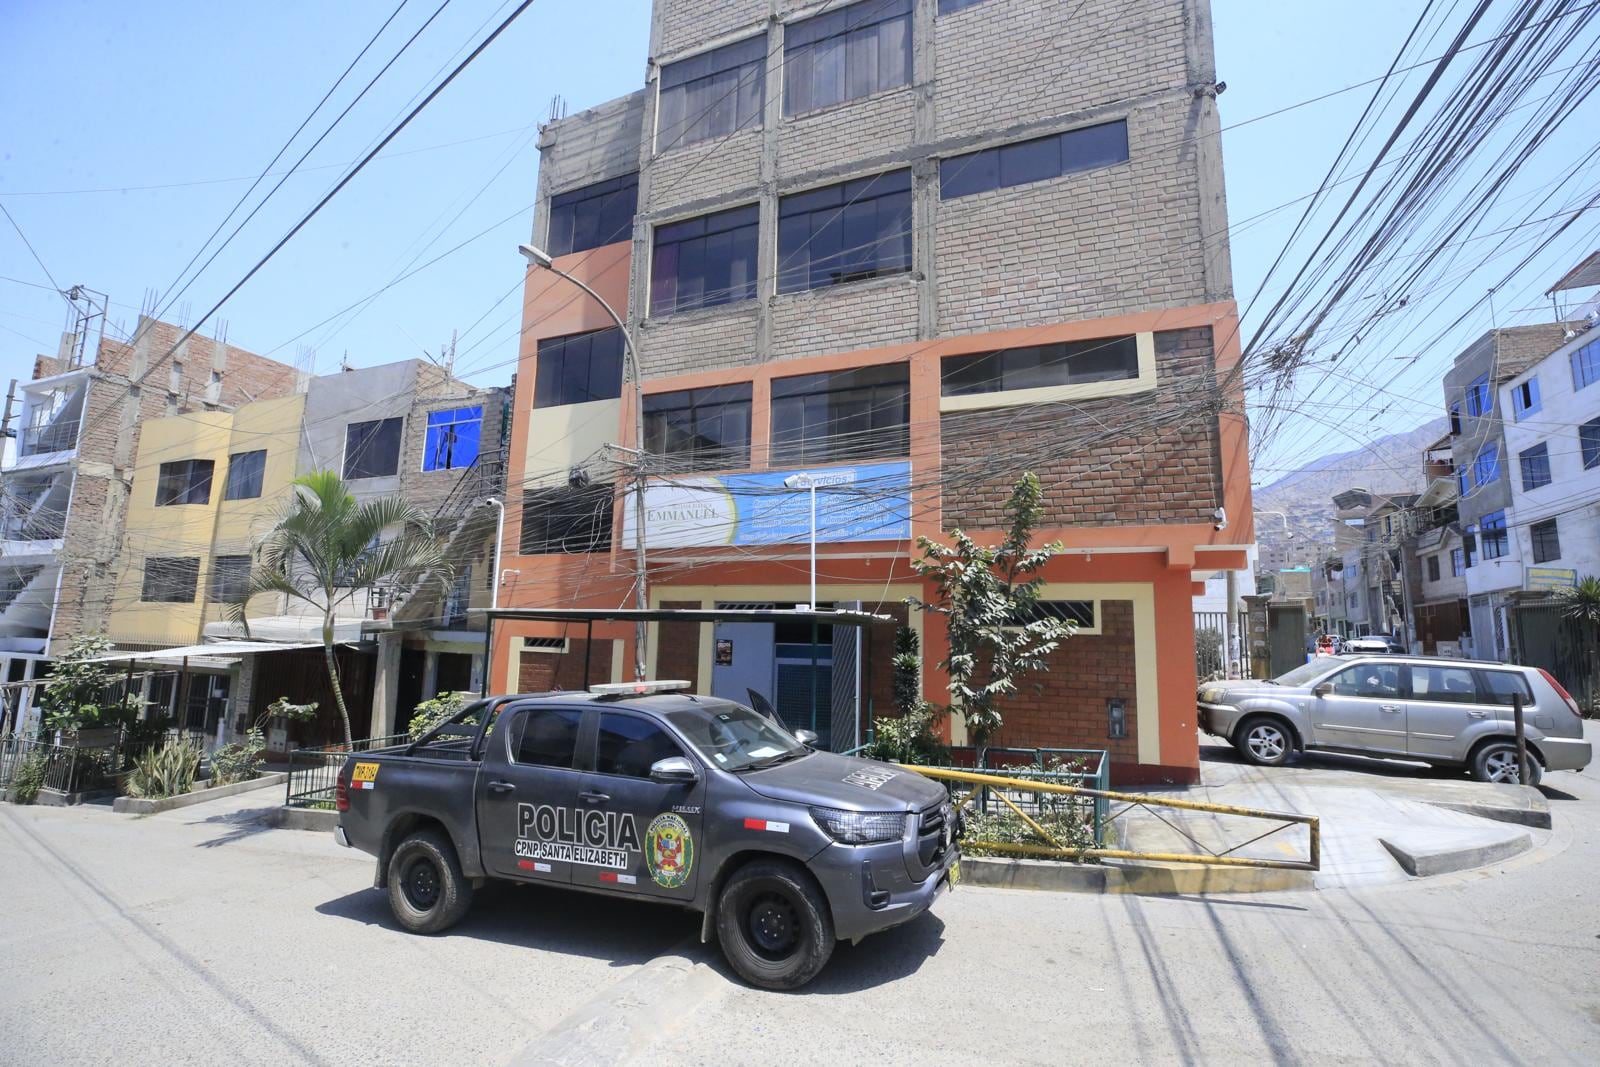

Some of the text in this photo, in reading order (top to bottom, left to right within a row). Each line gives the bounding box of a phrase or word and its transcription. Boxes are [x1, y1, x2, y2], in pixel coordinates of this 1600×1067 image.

[801, 475, 848, 487] rvicios
[648, 508, 720, 521] EMMANUEL
[518, 802, 641, 852] POLICIA
[542, 844, 571, 861] SANTA
[574, 848, 628, 867] ELIZABETH
